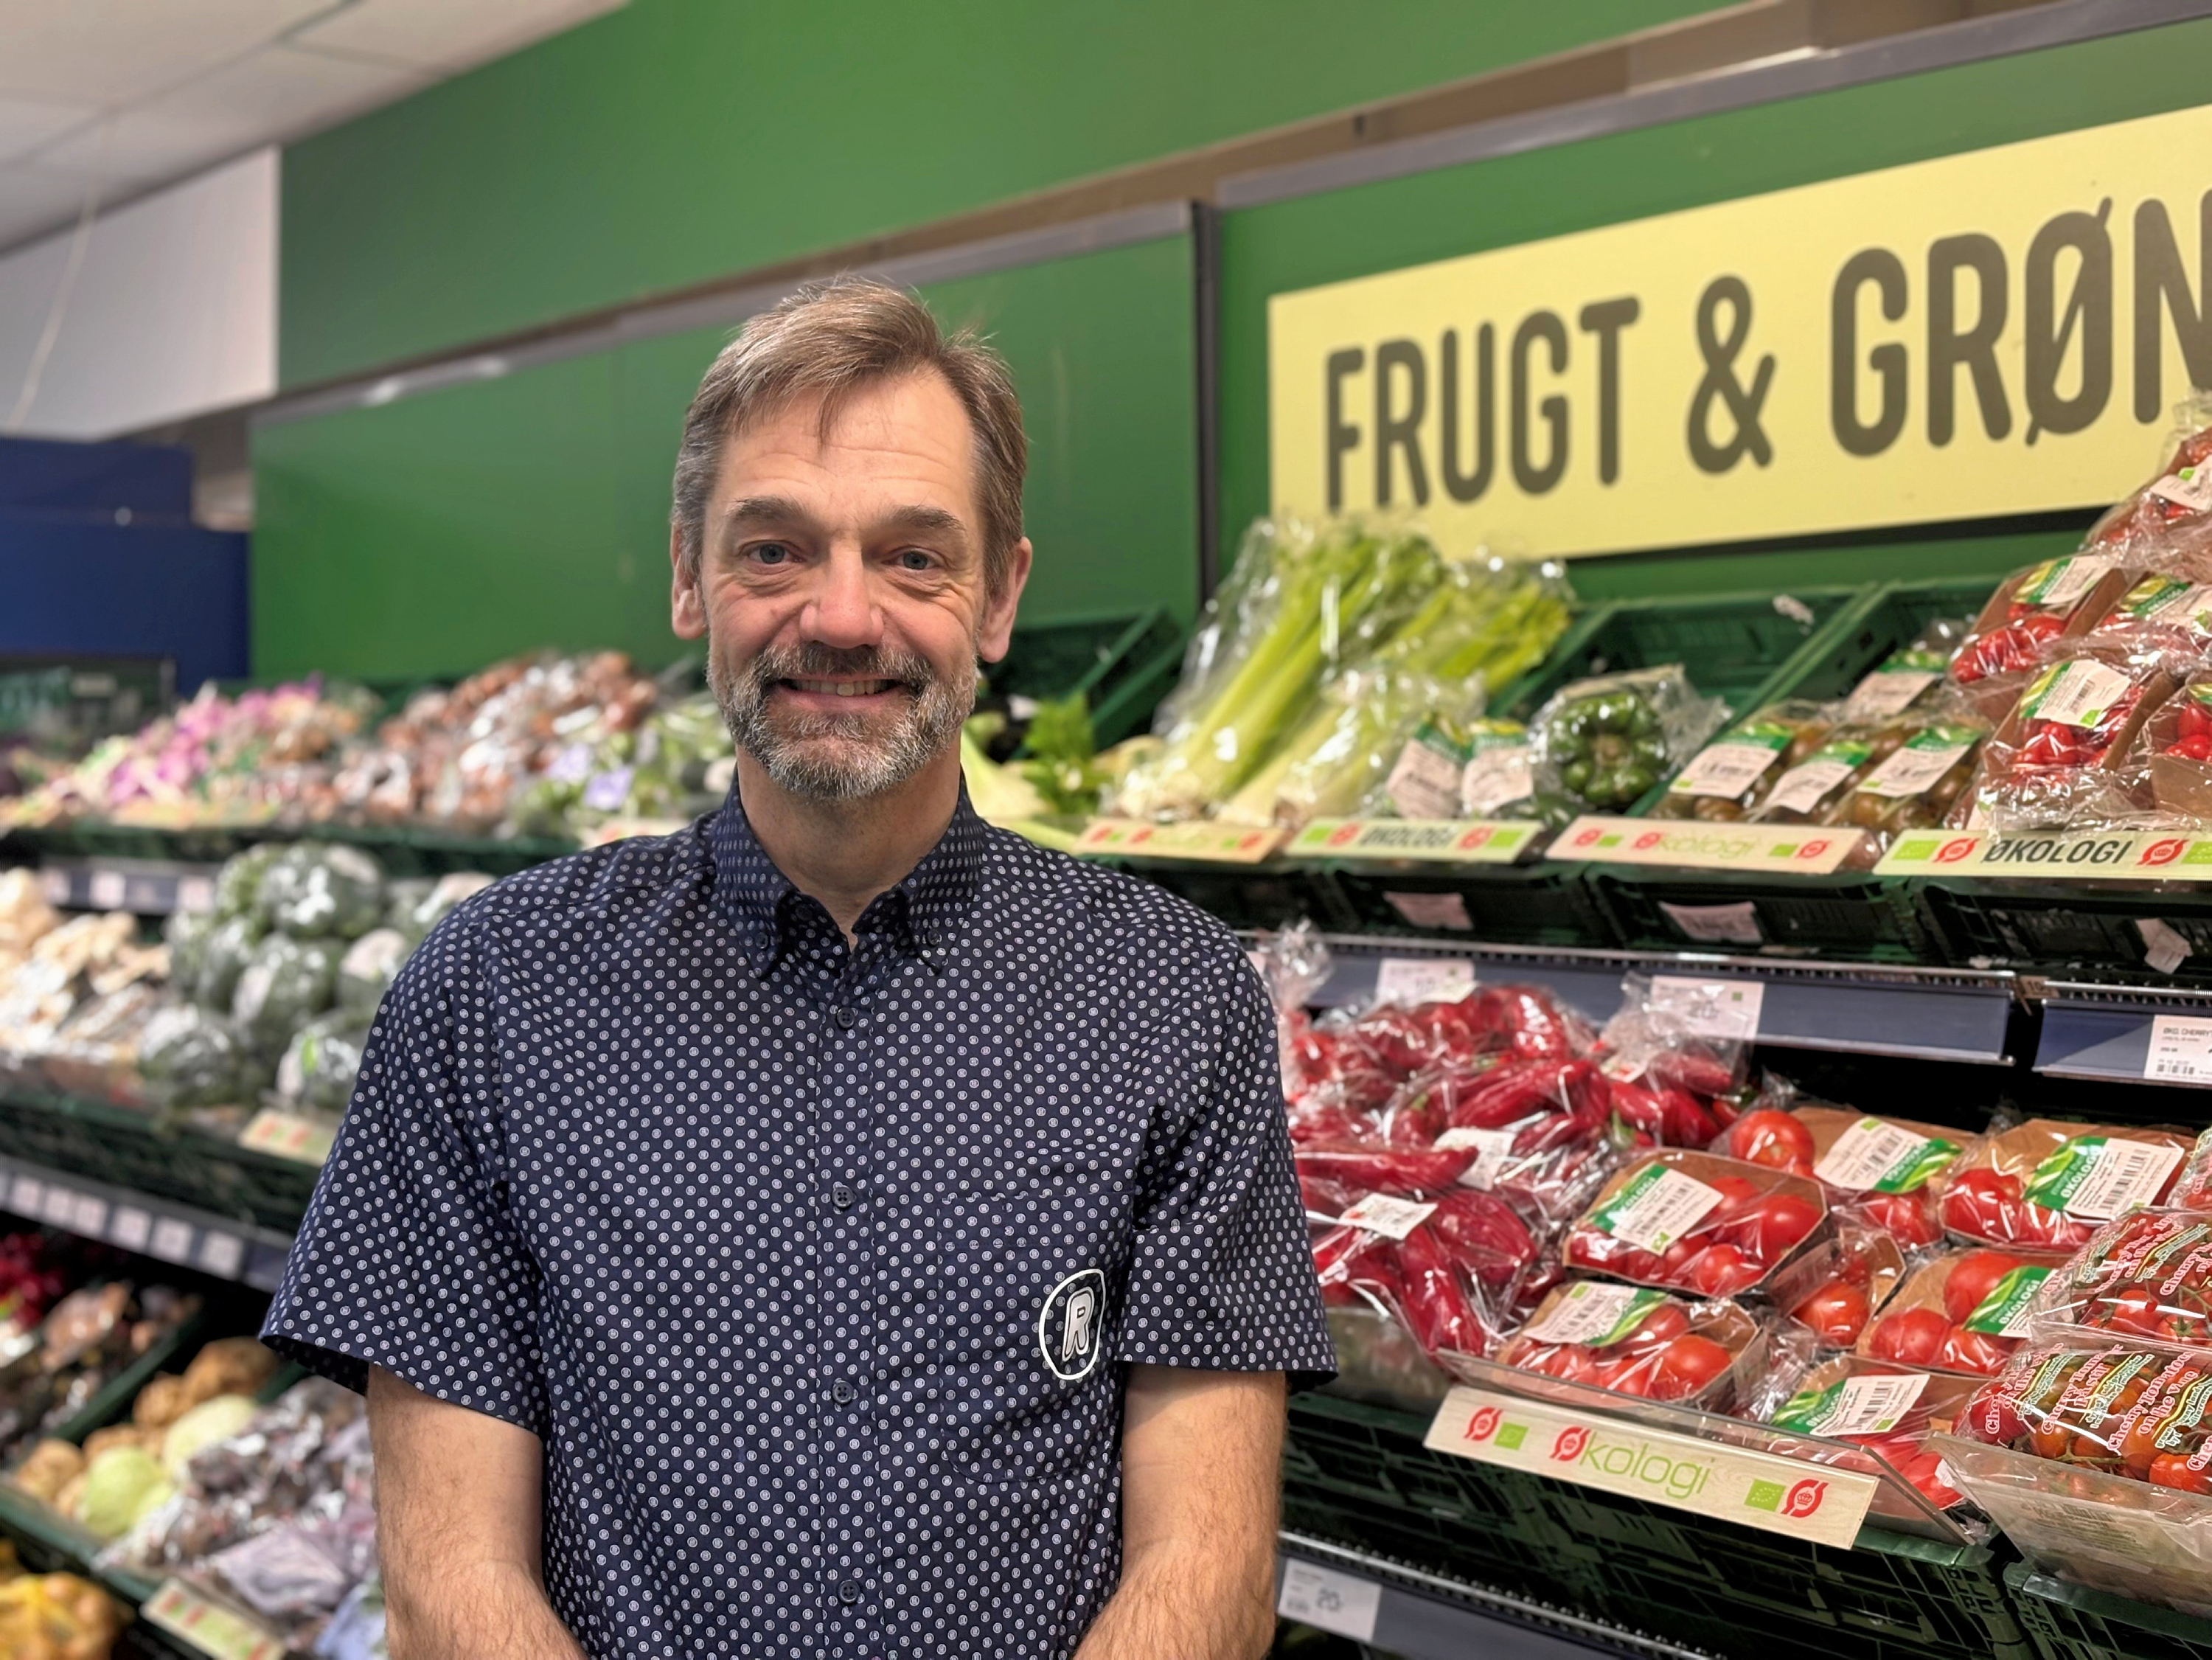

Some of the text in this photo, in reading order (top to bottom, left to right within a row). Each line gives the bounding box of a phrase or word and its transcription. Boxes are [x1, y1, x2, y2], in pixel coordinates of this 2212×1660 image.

[1325, 186, 2212, 510] FRUGT & GRØN
[1980, 838, 2133, 864] ØKOLOGI
[2160, 1251, 2205, 1295] Cherry
[1062, 1286, 1095, 1362] R
[2107, 1403, 2149, 1451] Cherry
[2138, 1414, 2160, 1435] on
[1549, 1425, 1716, 1499] Økologi
